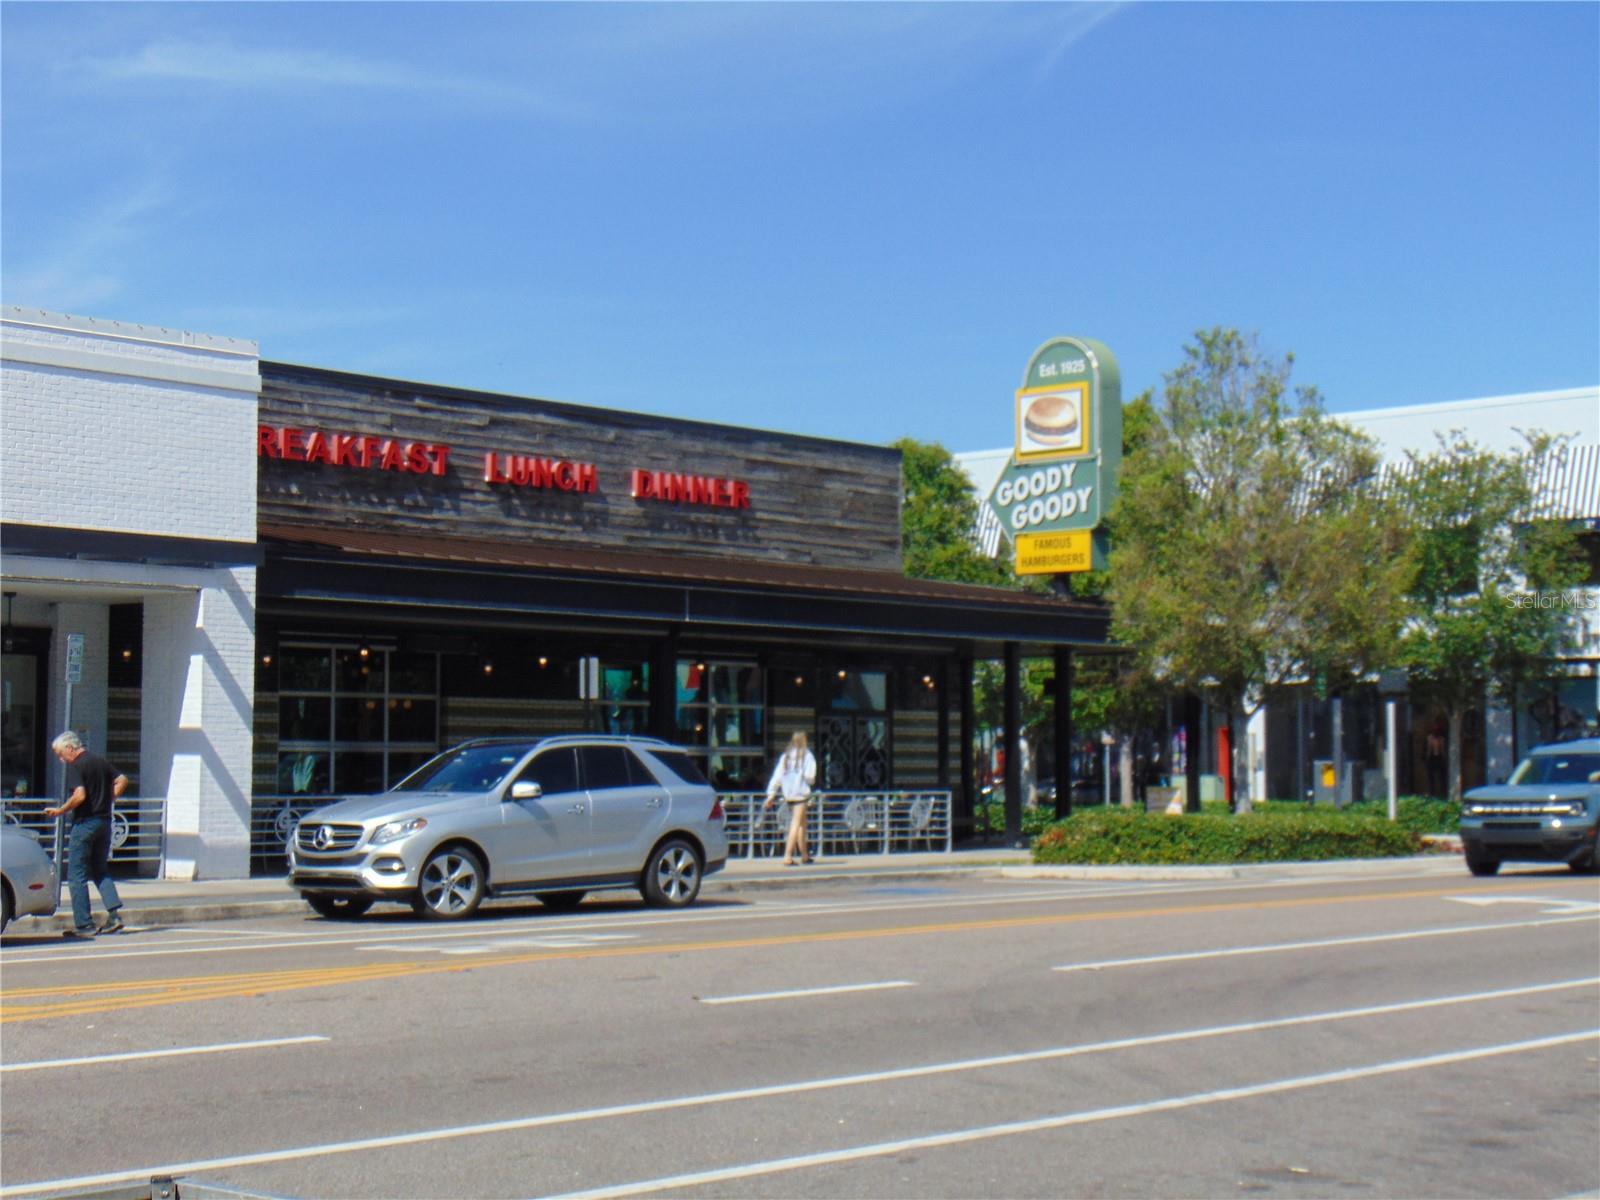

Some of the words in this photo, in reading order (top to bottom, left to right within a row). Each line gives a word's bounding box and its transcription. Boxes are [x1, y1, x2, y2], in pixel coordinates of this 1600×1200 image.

[1039, 363, 1058, 378] Est.
[1061, 359, 1085, 375] 1925
[257, 424, 449, 476] REAKFAST
[484, 452, 597, 493] LUNCH
[631, 469, 750, 509] DINNER
[996, 462, 1077, 506] GOODY
[1011, 486, 1093, 529] GOODY
[1034, 537, 1072, 550] FAMOUS
[1021, 553, 1085, 568] HAMBURGERS
